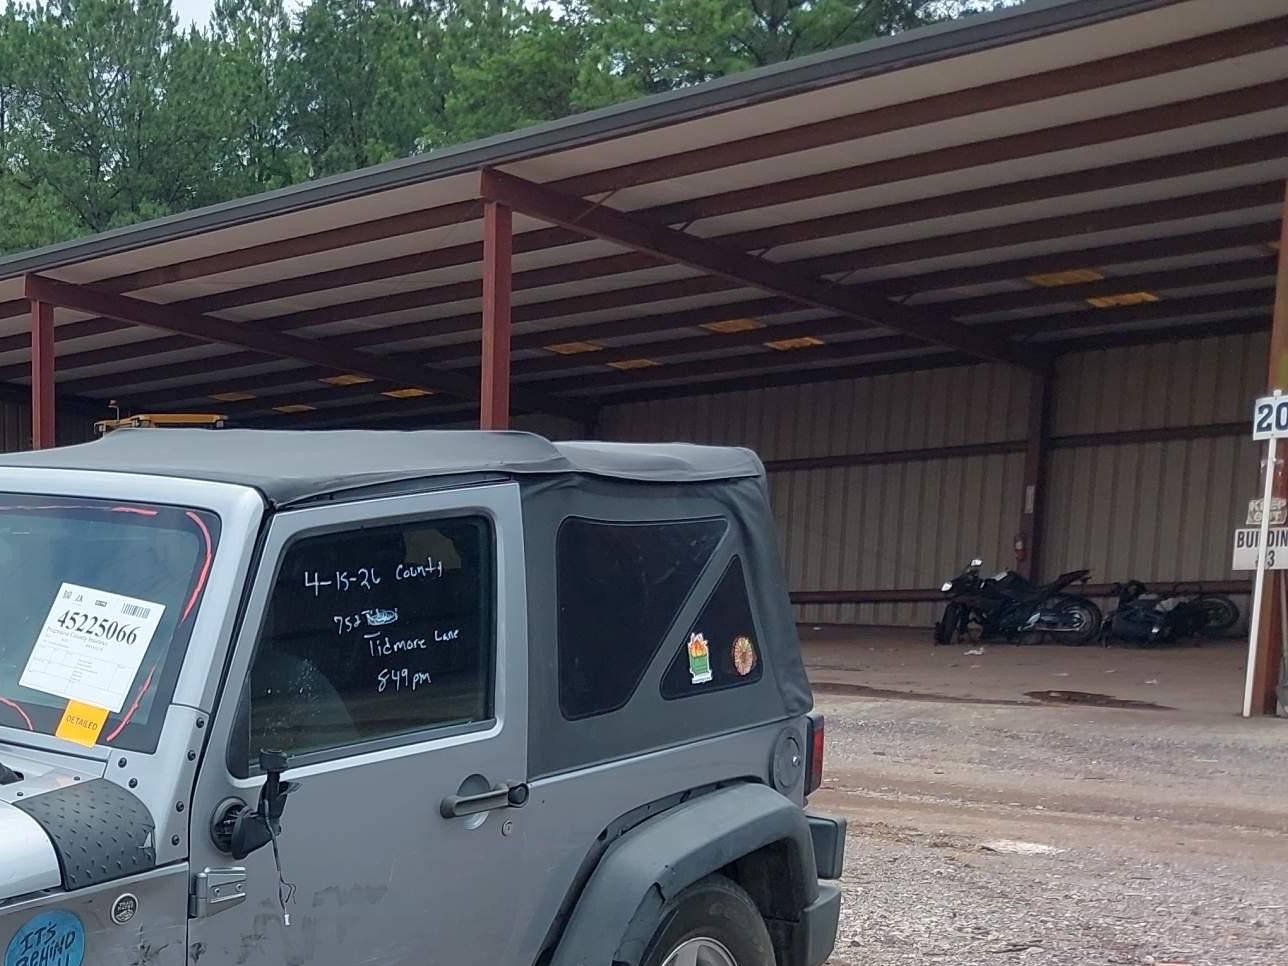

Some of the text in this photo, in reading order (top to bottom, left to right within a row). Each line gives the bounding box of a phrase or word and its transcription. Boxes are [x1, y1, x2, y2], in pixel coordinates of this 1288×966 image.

[1236, 529, 1288, 549] BUIDIN
[304, 556, 443, 597] 4-15-26 County
[57, 609, 141, 646] 45225066
[334, 614, 361, 635] 752
[363, 629, 460, 657] Tidmore Lane
[64, 712, 99, 732] DETAILED
[20, 920, 57, 955] IT'S
